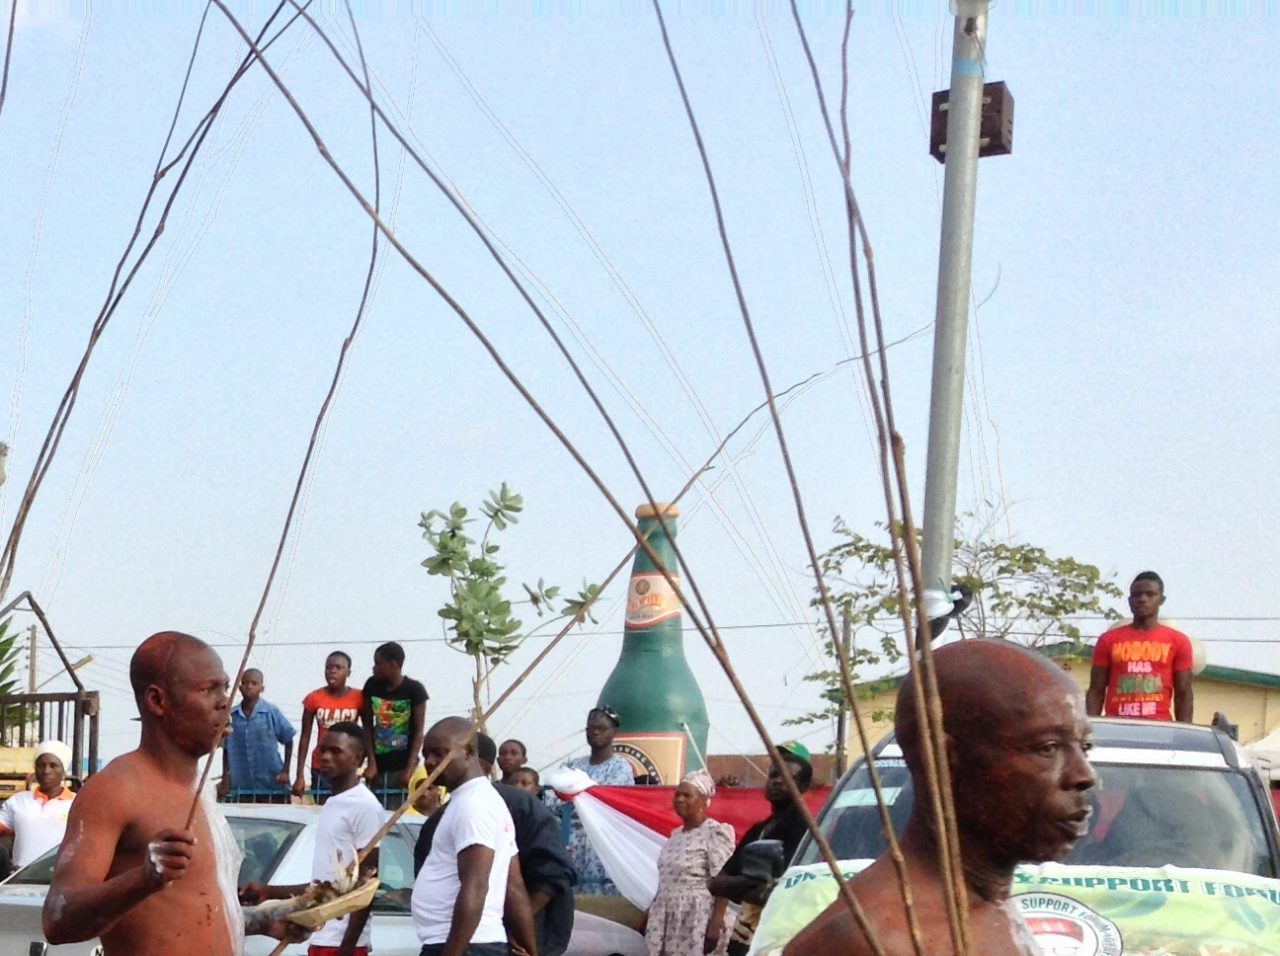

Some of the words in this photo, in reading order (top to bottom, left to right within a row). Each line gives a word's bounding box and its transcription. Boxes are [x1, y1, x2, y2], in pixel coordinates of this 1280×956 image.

[1112, 640, 1172, 663] NOBODY
[1127, 661, 1153, 674] HAS
[1118, 703, 1140, 716] LIKE
[1141, 702, 1157, 716] ME
[1021, 898, 1077, 914] SUPPORT
